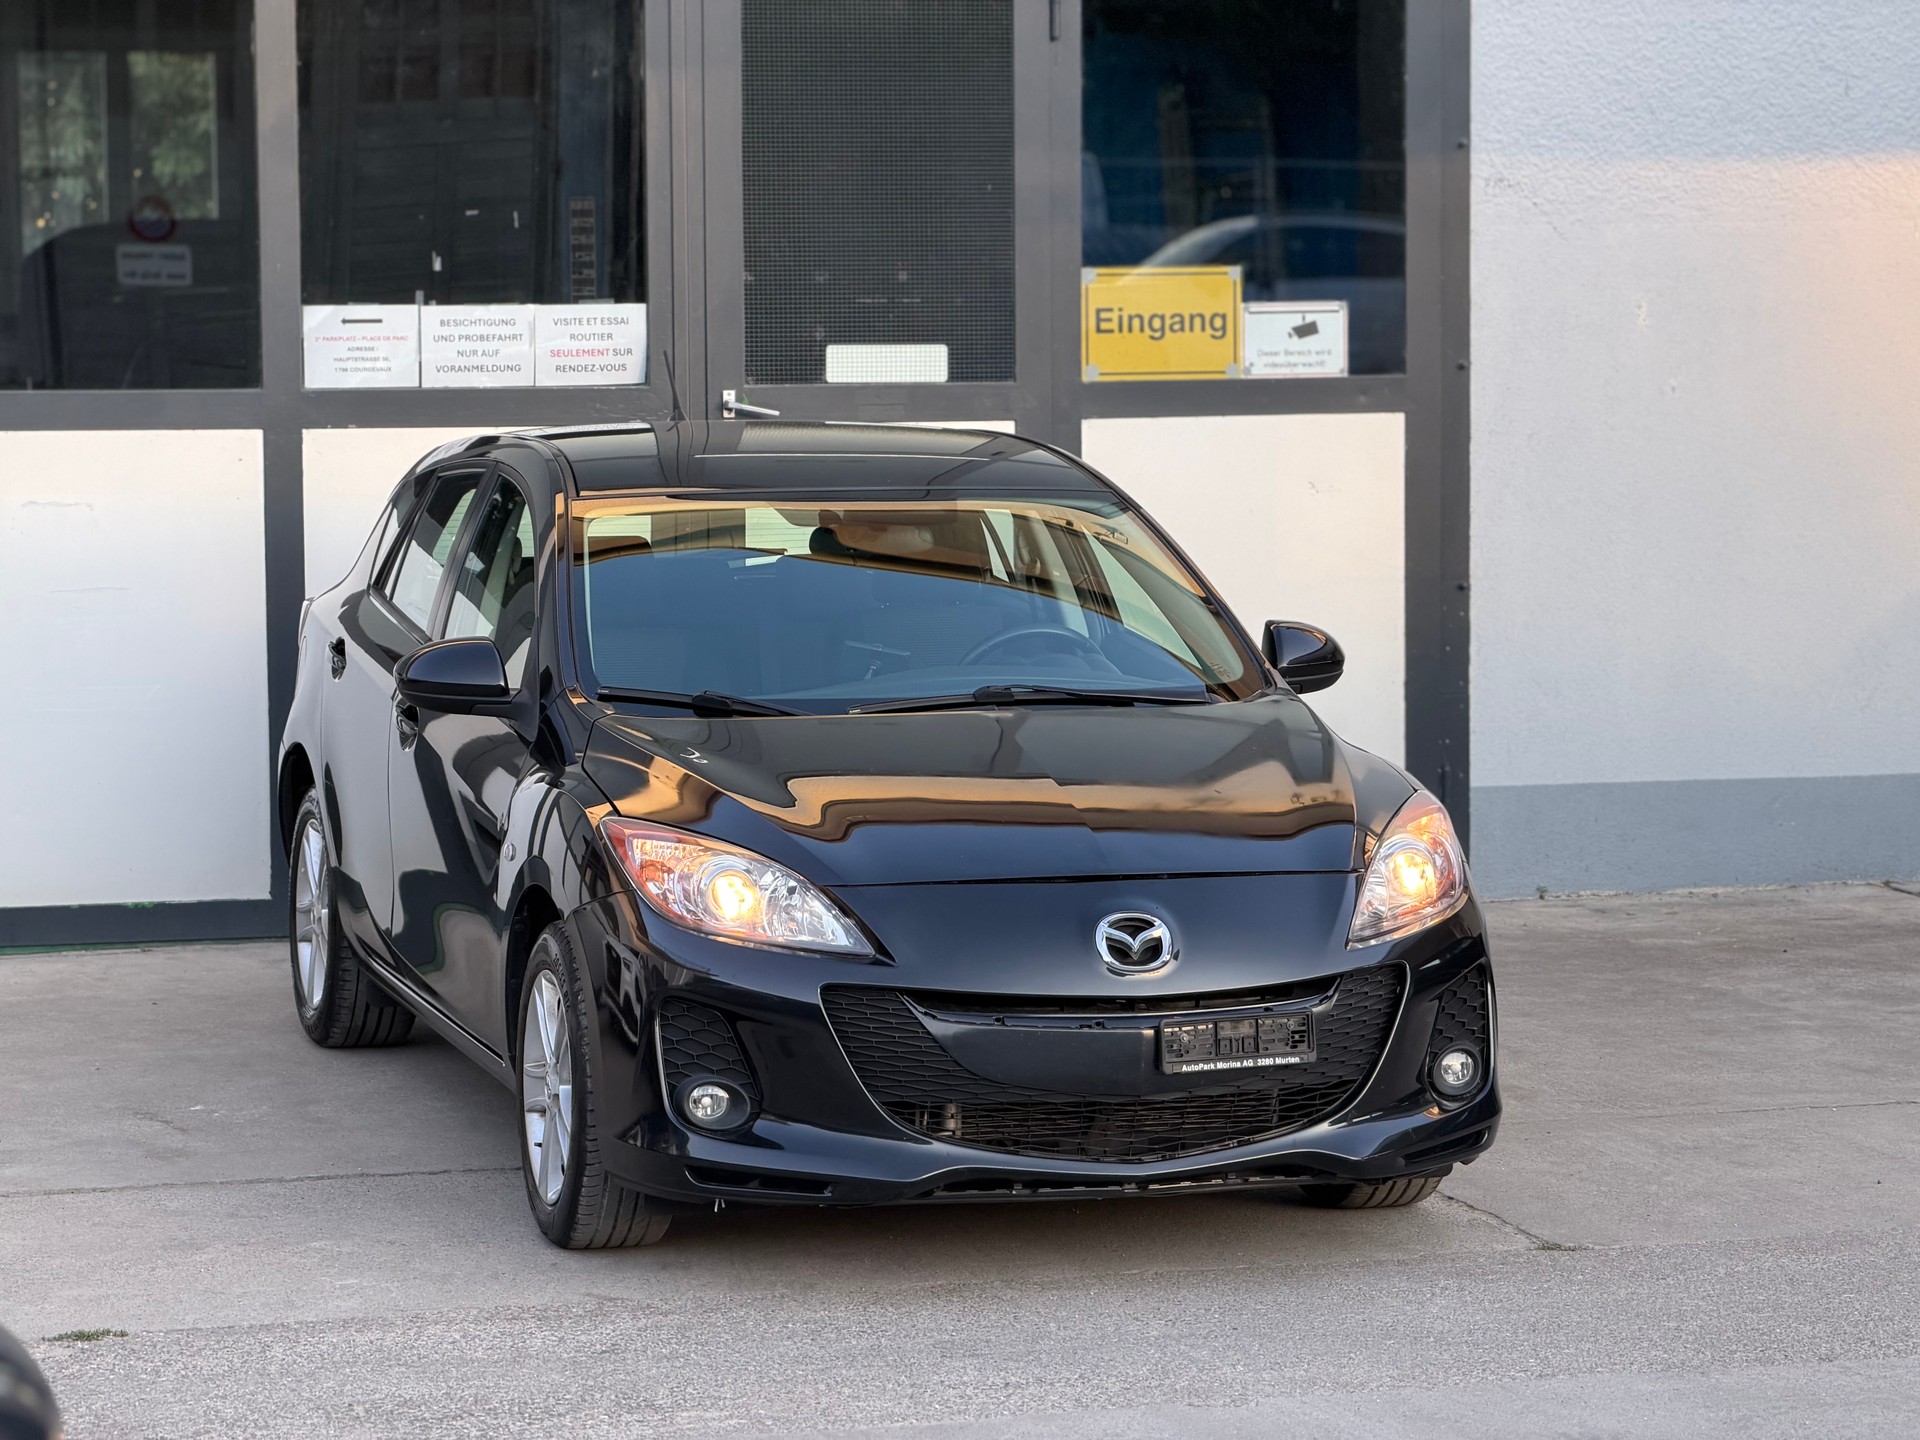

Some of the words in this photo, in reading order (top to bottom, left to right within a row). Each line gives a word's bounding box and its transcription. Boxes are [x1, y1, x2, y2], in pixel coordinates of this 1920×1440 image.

[440, 318, 516, 327] BESICHTIGUNG
[552, 318, 584, 326] VISITE
[586, 318, 598, 326] ET
[600, 317, 629, 325] ESSAI
[1095, 308, 1227, 340] Eingang
[433, 334, 456, 342] UND
[458, 333, 524, 342] PROBEFAHRT
[569, 333, 613, 341] ROUTIER
[457, 350, 478, 358] NUR
[480, 349, 500, 357] AUF
[550, 348, 610, 358] SEULEMENT
[612, 348, 633, 356] SUR
[436, 364, 522, 373] VORANMELDUNG
[555, 363, 627, 373] RENDEZ-VOUS
[1182, 1063, 1215, 1072] AutoPark
[1216, 1060, 1240, 1069] Morina
[1257, 1057, 1274, 1066] 3280
[1275, 1056, 1300, 1065] Murten
